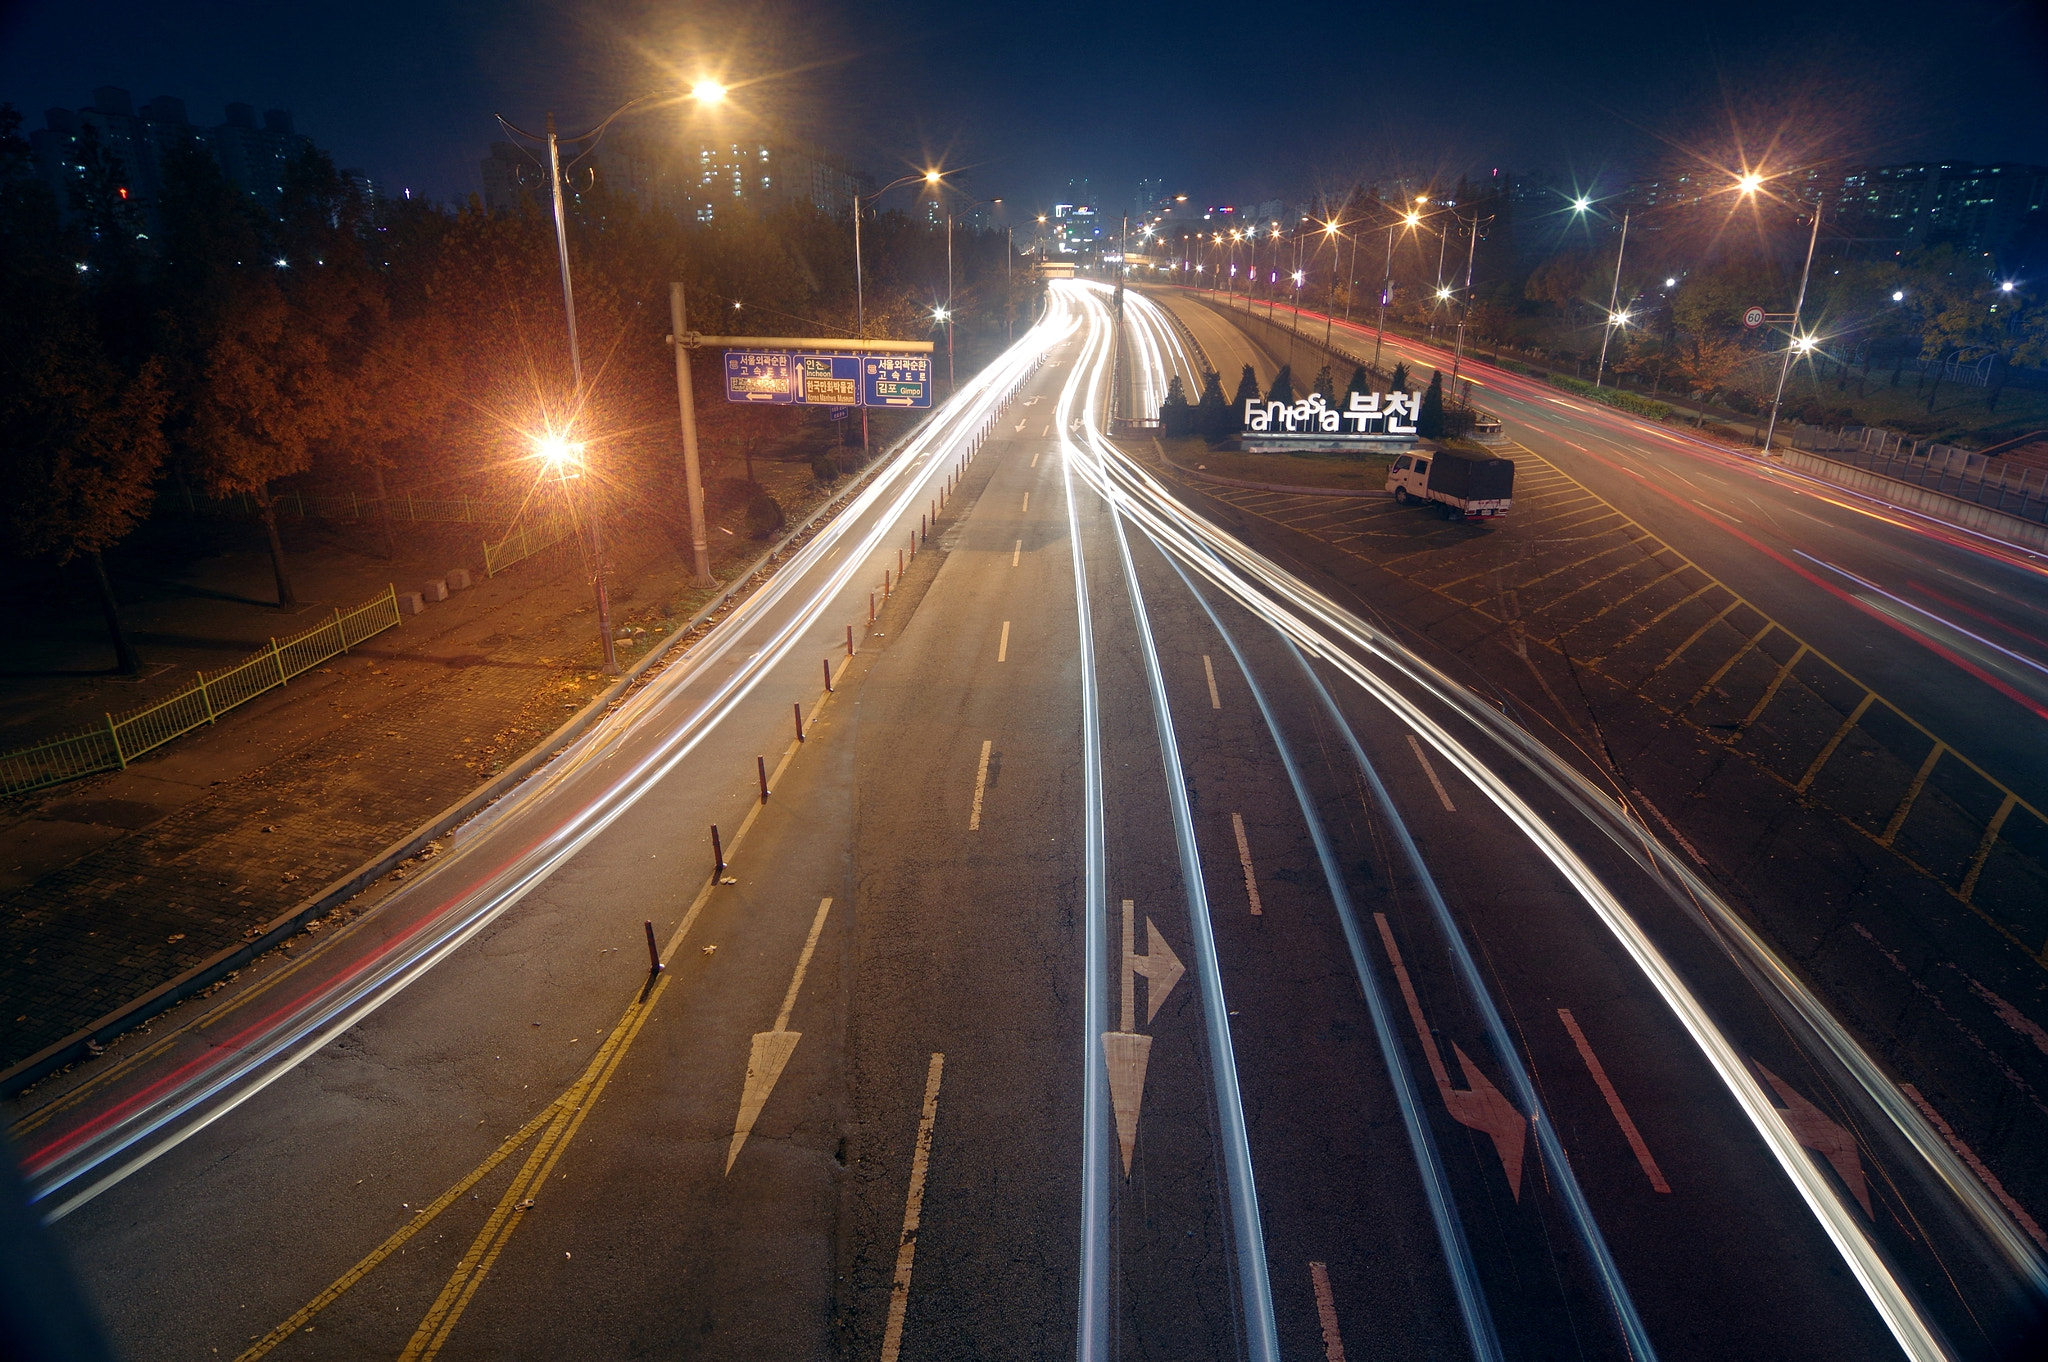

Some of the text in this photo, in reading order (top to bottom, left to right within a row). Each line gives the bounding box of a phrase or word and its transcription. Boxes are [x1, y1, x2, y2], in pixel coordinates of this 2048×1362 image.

[1747, 313, 1761, 322] 60
[740, 355, 787, 366] 서울외곽순환
[878, 359, 926, 371] 서울외곽순환
[806, 380, 854, 394] 한국만화박물관
[878, 383, 921, 396] 김포 Gimpo
[1244, 390, 1422, 434] Fantasia 부천
